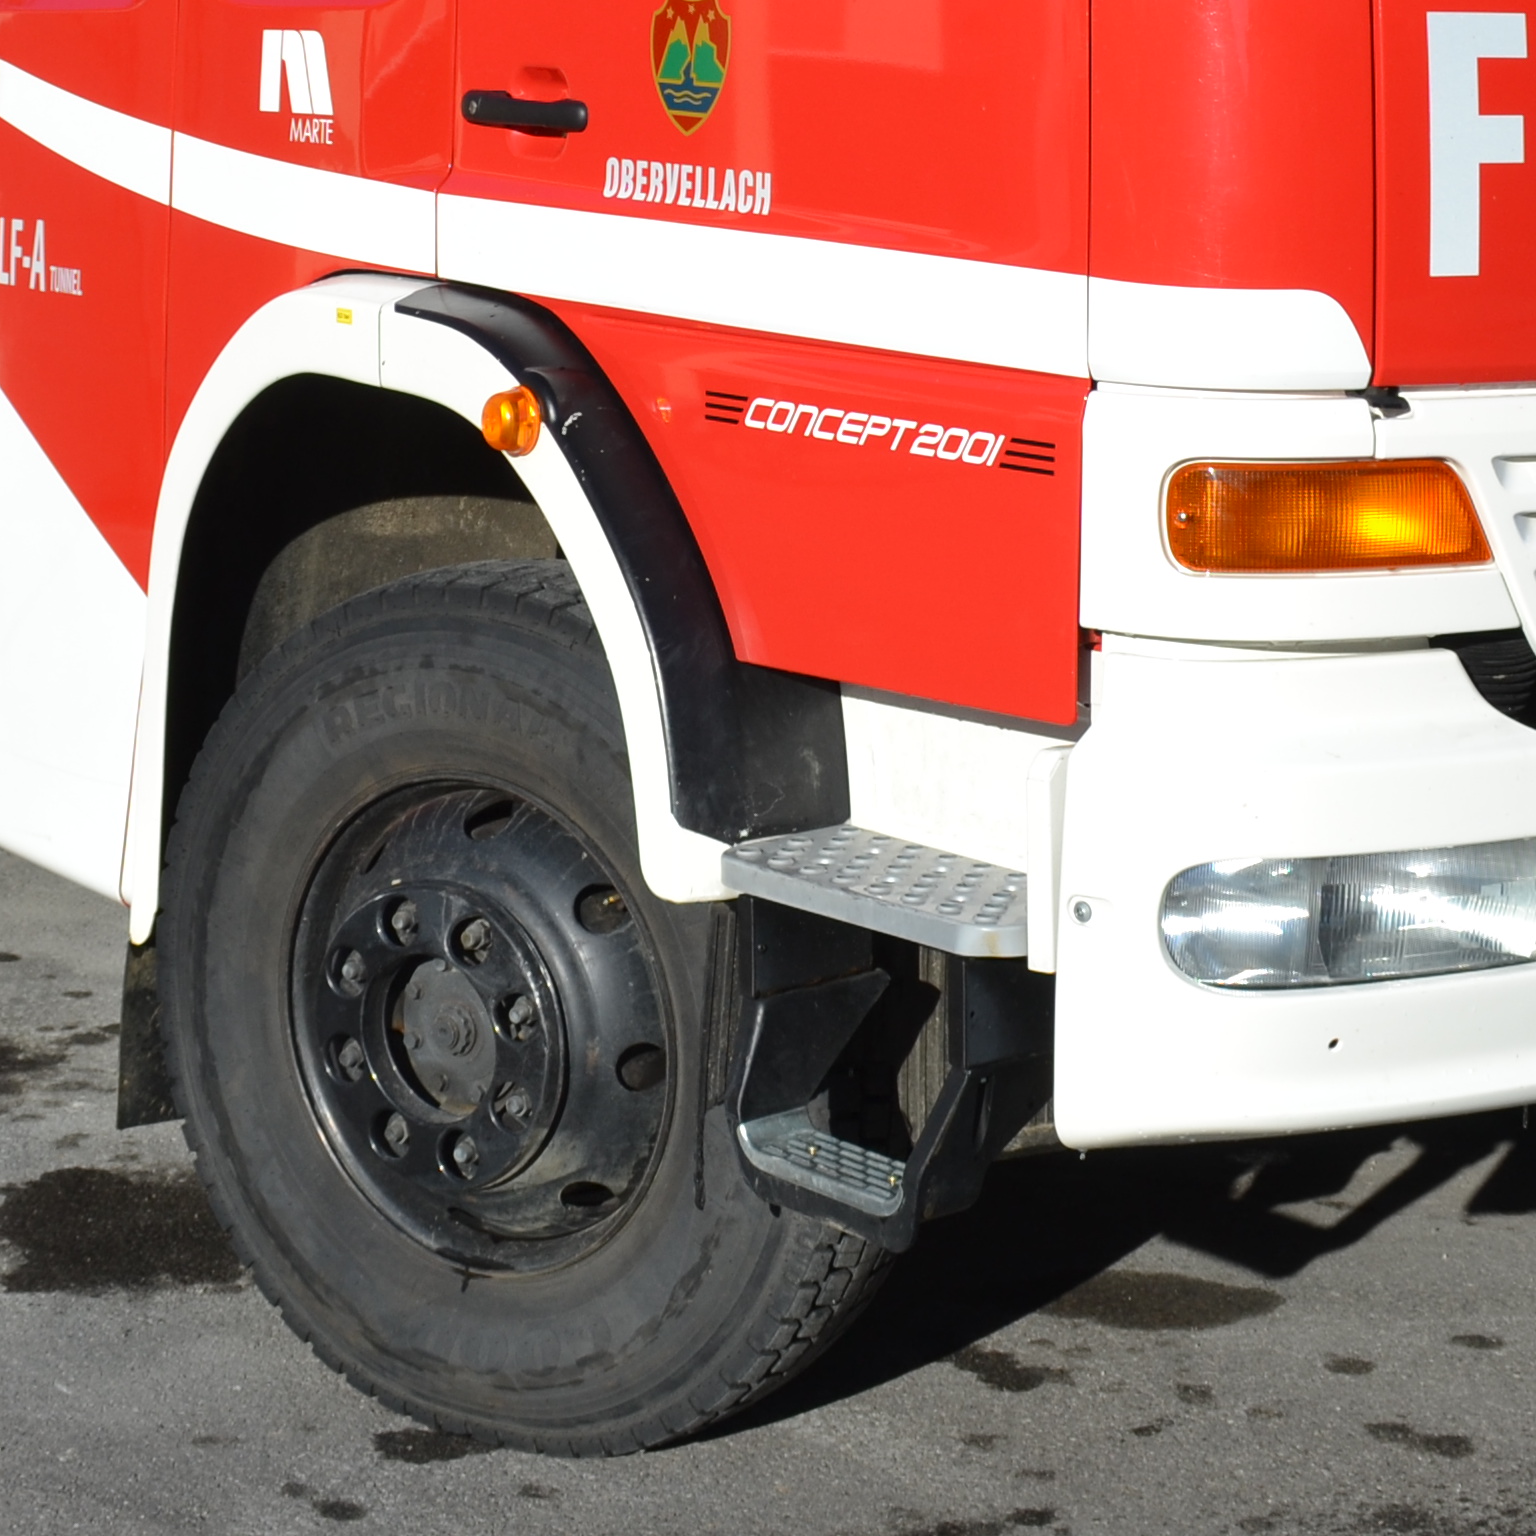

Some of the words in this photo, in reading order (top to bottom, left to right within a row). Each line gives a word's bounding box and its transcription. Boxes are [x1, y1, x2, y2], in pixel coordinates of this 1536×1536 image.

[289, 117, 334, 145] MARTE
[602, 157, 772, 215] OBERVELLACH
[49, 265, 83, 296] TUNNEL
